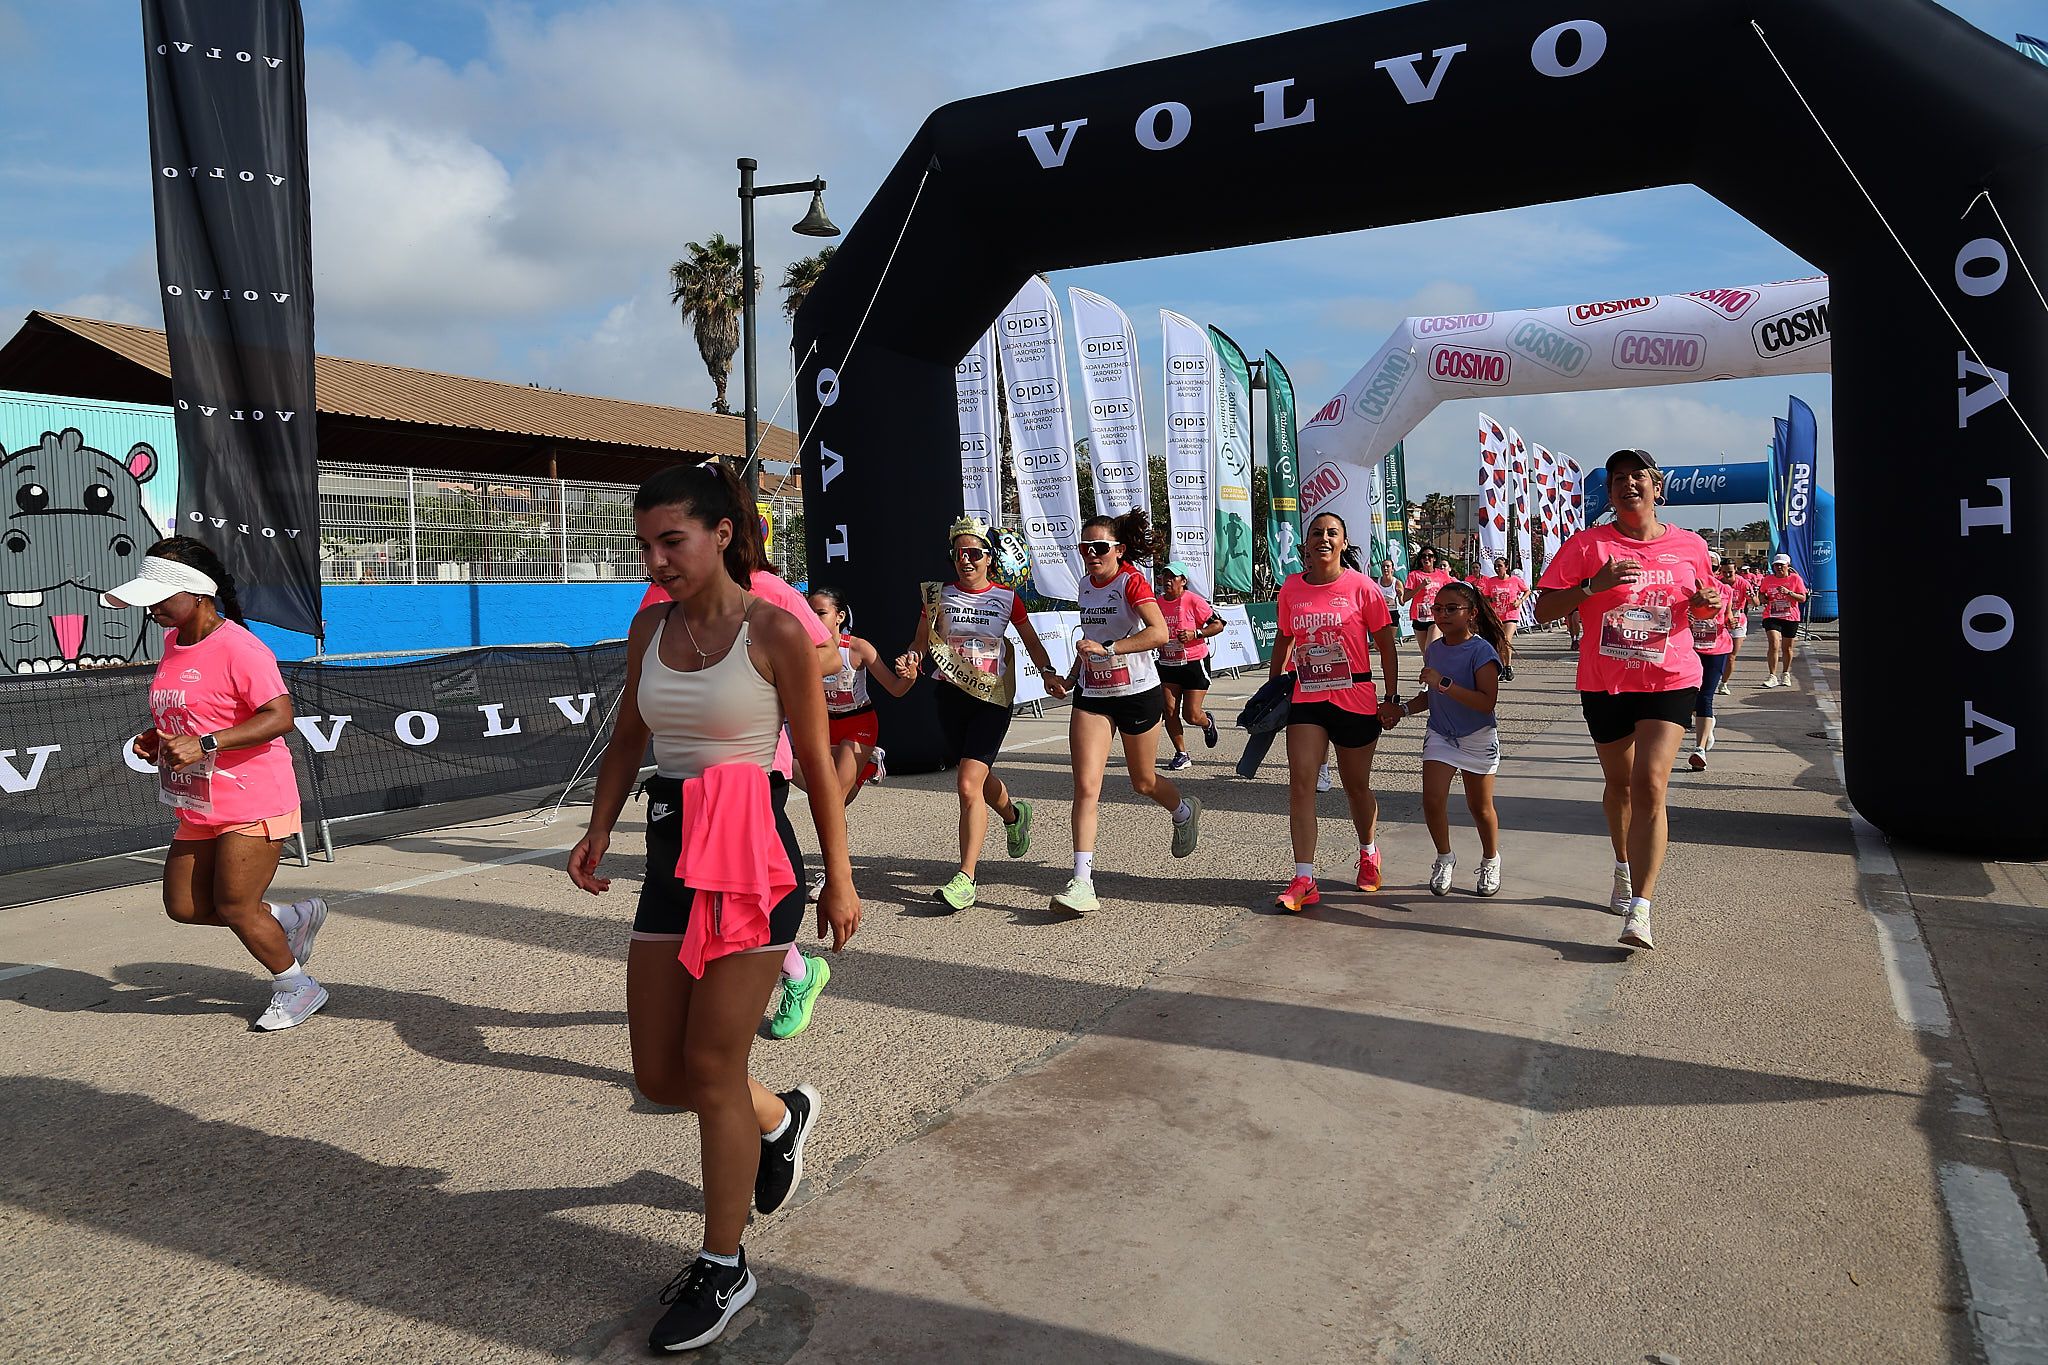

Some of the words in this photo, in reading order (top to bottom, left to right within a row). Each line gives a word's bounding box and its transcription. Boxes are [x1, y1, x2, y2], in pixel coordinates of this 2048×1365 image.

[1017, 19, 1608, 170] VOLVO
[1576, 297, 1651, 320] COSMO
[1420, 314, 1488, 333] COSMO
[1761, 303, 1831, 351] COSM
[1514, 322, 1585, 372] COSMO
[1620, 335, 1699, 367] COSMO
[1435, 349, 1504, 382] COSMO
[1359, 354, 1411, 417] COSMO
[816, 368, 849, 564] LVO
[1954, 237, 2016, 776] VOLVO
[1293, 612, 1343, 630] CARRERA
[1623, 629, 1649, 640] 016
[929, 646, 992, 693] umpleaños
[1093, 670, 1113, 680] 016
[1312, 663, 1332, 674] 016
[1625, 660, 1640, 670] 026
[151, 689, 186, 709] RRERA
[825, 690, 838, 699] 16
[294, 693, 597, 753] VOLV
[170, 772, 192, 786] 016
